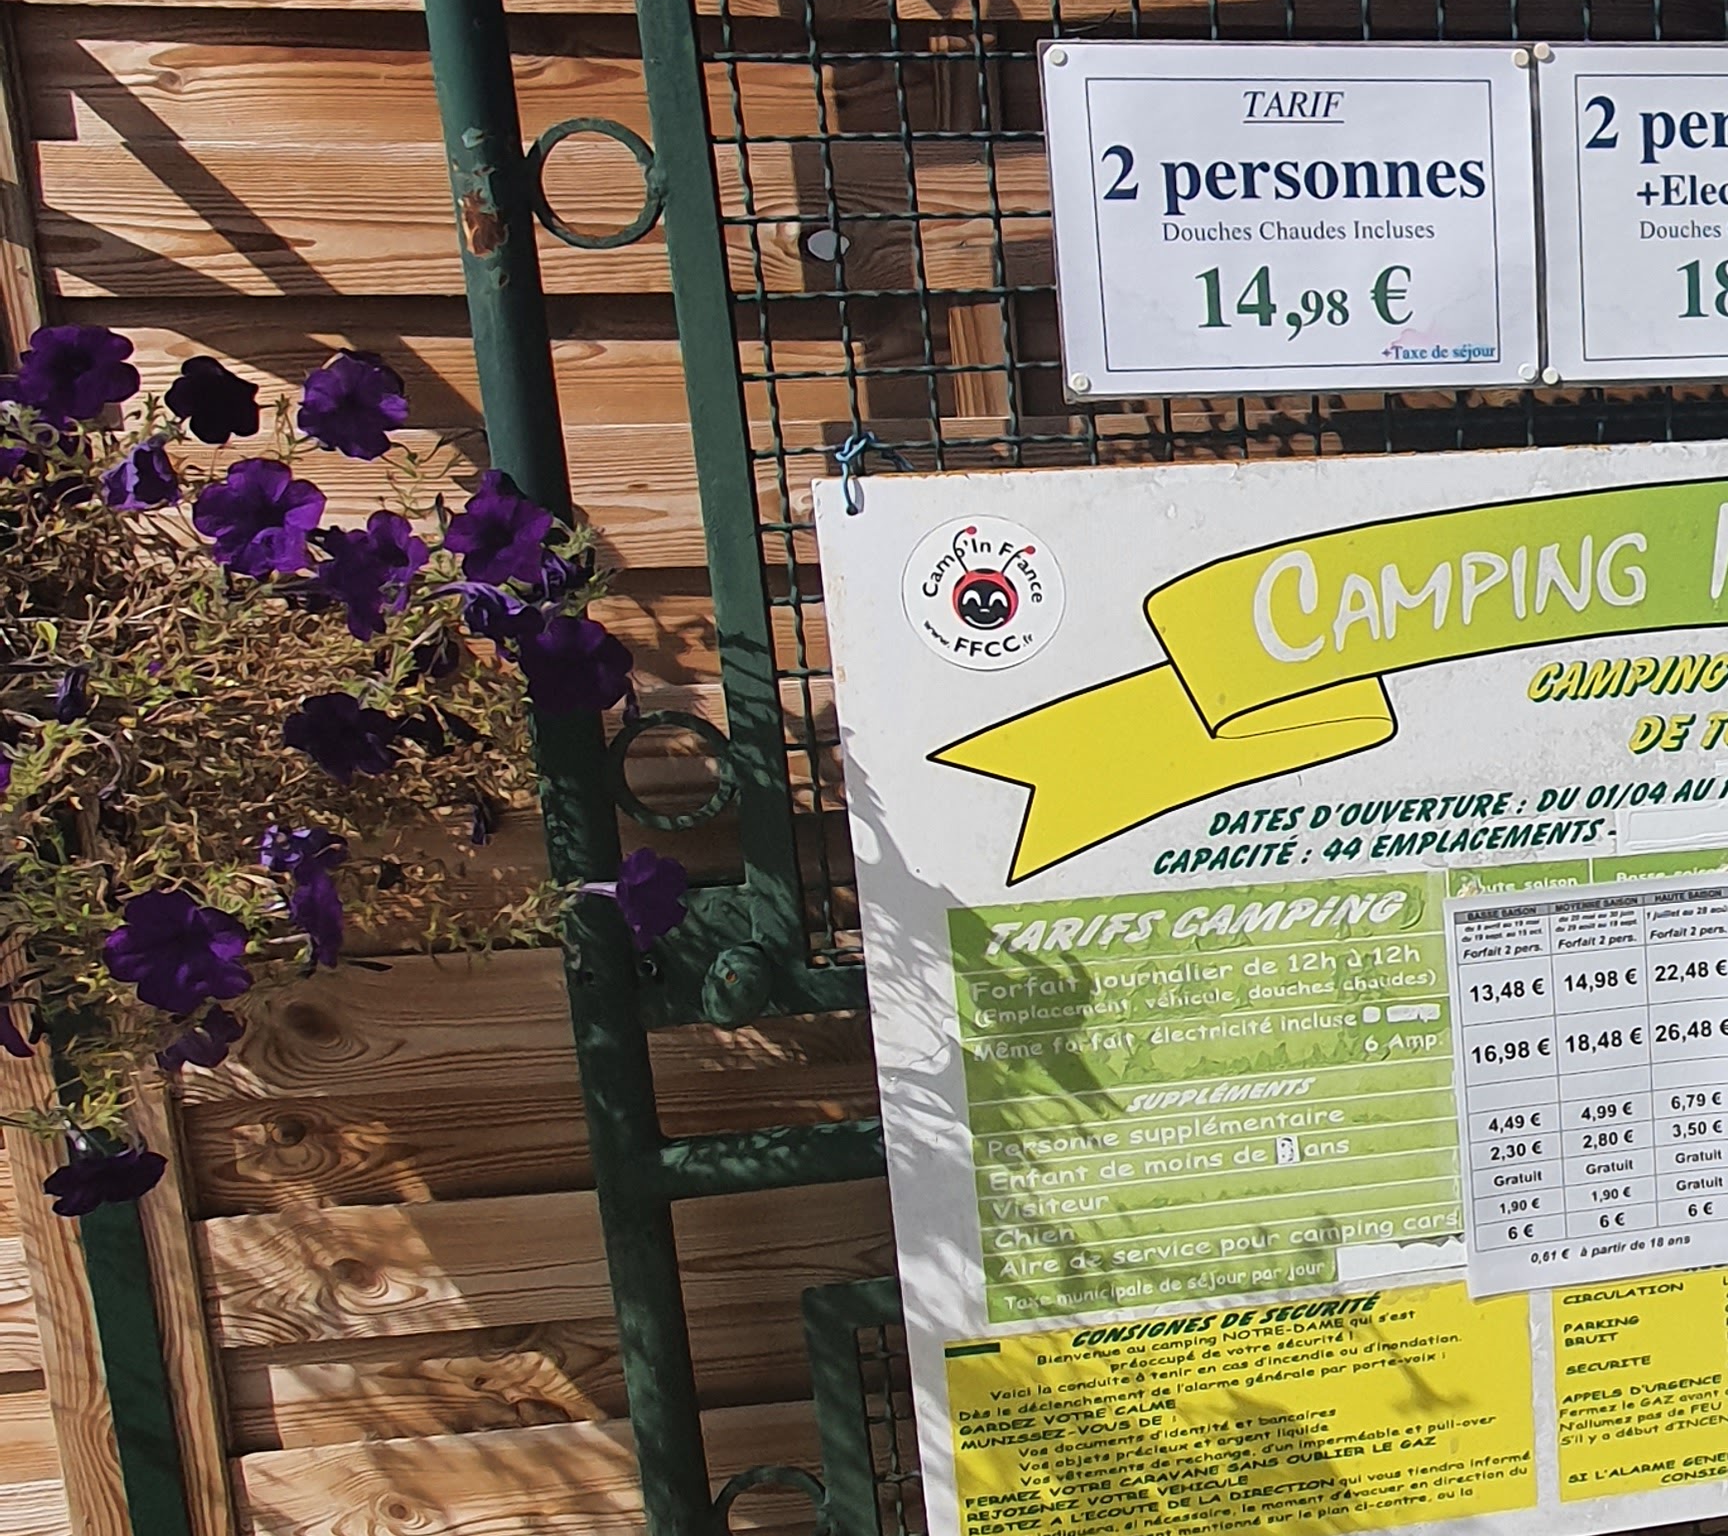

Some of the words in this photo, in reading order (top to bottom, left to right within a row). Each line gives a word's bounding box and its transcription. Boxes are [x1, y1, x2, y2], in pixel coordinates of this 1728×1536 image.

[1243, 91, 1344, 120] TARIF
[1585, 95, 1619, 149] 2
[1101, 144, 1139, 201] 2
[1161, 157, 1486, 215] personnes
[1162, 221, 1252, 242] Douches
[1259, 221, 1346, 241] Chaudes
[1353, 220, 1434, 240] Incluses
[1640, 220, 1721, 240] Douches
[1198, 264, 1349, 342] 14,98
[1370, 264, 1414, 327] €
[1381, 344, 1427, 361] +Taxe
[1431, 344, 1448, 360] de
[1452, 343, 1495, 362] séjour
[1252, 532, 1648, 662] CAMPING
[1628, 713, 1695, 755] DE
[1209, 806, 1305, 837] DATES
[1537, 789, 1580, 813] DU
[1585, 782, 1667, 812] 01/04
[1673, 777, 1716, 803] AU
[1153, 835, 1299, 875] CAPACITÉ
[1323, 837, 1362, 862] 44
[1370, 817, 1604, 859] EMPLACEMENTS
[985, 909, 1167, 956] TARIFS
[1171, 890, 1407, 939] CAMPING
[1650, 928, 1688, 940] Forfait
[1690, 927, 1697, 936] 2
[1700, 925, 1728, 937] pers.
[1463, 946, 1501, 959] Forfait
[1505, 946, 1511, 954] 2
[1515, 944, 1543, 956] pers.
[1558, 937, 1596, 950] Forfait
[1600, 936, 1606, 945] 2
[1609, 934, 1637, 946] pers.
[972, 976, 1079, 1002] Forfait
[1090, 963, 1233, 996] journalier
[1244, 957, 1278, 976] de
[1288, 951, 1336, 973] 12h
[1373, 944, 1421, 966] 12h
[1564, 970, 1618, 993] 14,98
[1625, 968, 1638, 985] €
[1654, 961, 1709, 983] 22,48
[1715, 960, 1728, 976] €
[1248, 979, 1334, 999] douches
[1469, 983, 1525, 1004] 13,48
[1532, 978, 1545, 995] €
[974, 1041, 1043, 1061] Même
[1052, 1032, 1135, 1054] forfait
[1150, 1017, 1273, 1045] électricité
[1281, 1012, 1357, 1032] incluse
[1365, 1036, 1378, 1052] 6
[1565, 1030, 1622, 1054] 18,48
[1630, 1027, 1643, 1045] €
[1655, 1020, 1711, 1044] 26,48
[1471, 1041, 1530, 1065] 16,98
[1537, 1038, 1550, 1056] €
[1125, 1076, 1316, 1113] SUPPLÉMENTS
[1671, 1093, 1706, 1110] 6,79
[1712, 1092, 1722, 1106] €
[1489, 1115, 1524, 1133] 4,49
[1530, 1113, 1541, 1127] €
[1581, 1104, 1617, 1122] 4,99
[1623, 1101, 1633, 1116] €
[987, 1133, 1120, 1158] Personne
[1129, 1107, 1345, 1146] supplémentaire
[1583, 1132, 1618, 1150] 2,80
[1623, 1130, 1633, 1144] €
[1672, 1122, 1706, 1139] 3,50
[1713, 1120, 1722, 1134] €
[1490, 1144, 1526, 1162] 2,30
[1532, 1140, 1542, 1155] €
[1675, 1149, 1722, 1164] Gratuit
[989, 1165, 1088, 1191] Enfant
[1100, 1161, 1135, 1179] de
[1144, 1152, 1223, 1175] moins
[1233, 1146, 1268, 1164] de
[1304, 1139, 1350, 1157] ans
[1586, 1159, 1634, 1176] Gratuit
[1493, 1170, 1543, 1188] Gratuit
[1676, 1177, 1724, 1191] Gratuit
[992, 1195, 1110, 1219] Visiteur
[995, 1227, 1076, 1248] Chien
[1000, 1258, 1060, 1277] Aire
[1070, 1253, 1102, 1269] de
[1111, 1241, 1212, 1265] service
[1221, 1232, 1280, 1256] pour
[1290, 1219, 1394, 1245] camping
[1403, 1211, 1458, 1230] cars
[1004, 1295, 1056, 1311] Taxe
[1056, 1280, 1153, 1307] municipale
[1159, 1277, 1181, 1292] de
[1187, 1270, 1246, 1292] séjour
[1252, 1269, 1281, 1283] par
[1288, 1261, 1324, 1281] jour
[1563, 1283, 1684, 1305] CIRCULATION
[1071, 1315, 1216, 1348] CONSIGNES
[1220, 1309, 1258, 1330] DE
[1259, 1292, 1381, 1324] SECURITÉ
[1563, 1316, 1640, 1333] PARKING
[1565, 1332, 1619, 1347] BRUIT
[1565, 1356, 1651, 1376] SECURITE
[1562, 1388, 1622, 1404] APPELS
[1630, 1375, 1722, 1396] D'URGENCE
[960, 1419, 1035, 1436] GARDEZ
[1044, 1408, 1107, 1426] VOTRE
[1114, 1400, 1177, 1416] CALME
